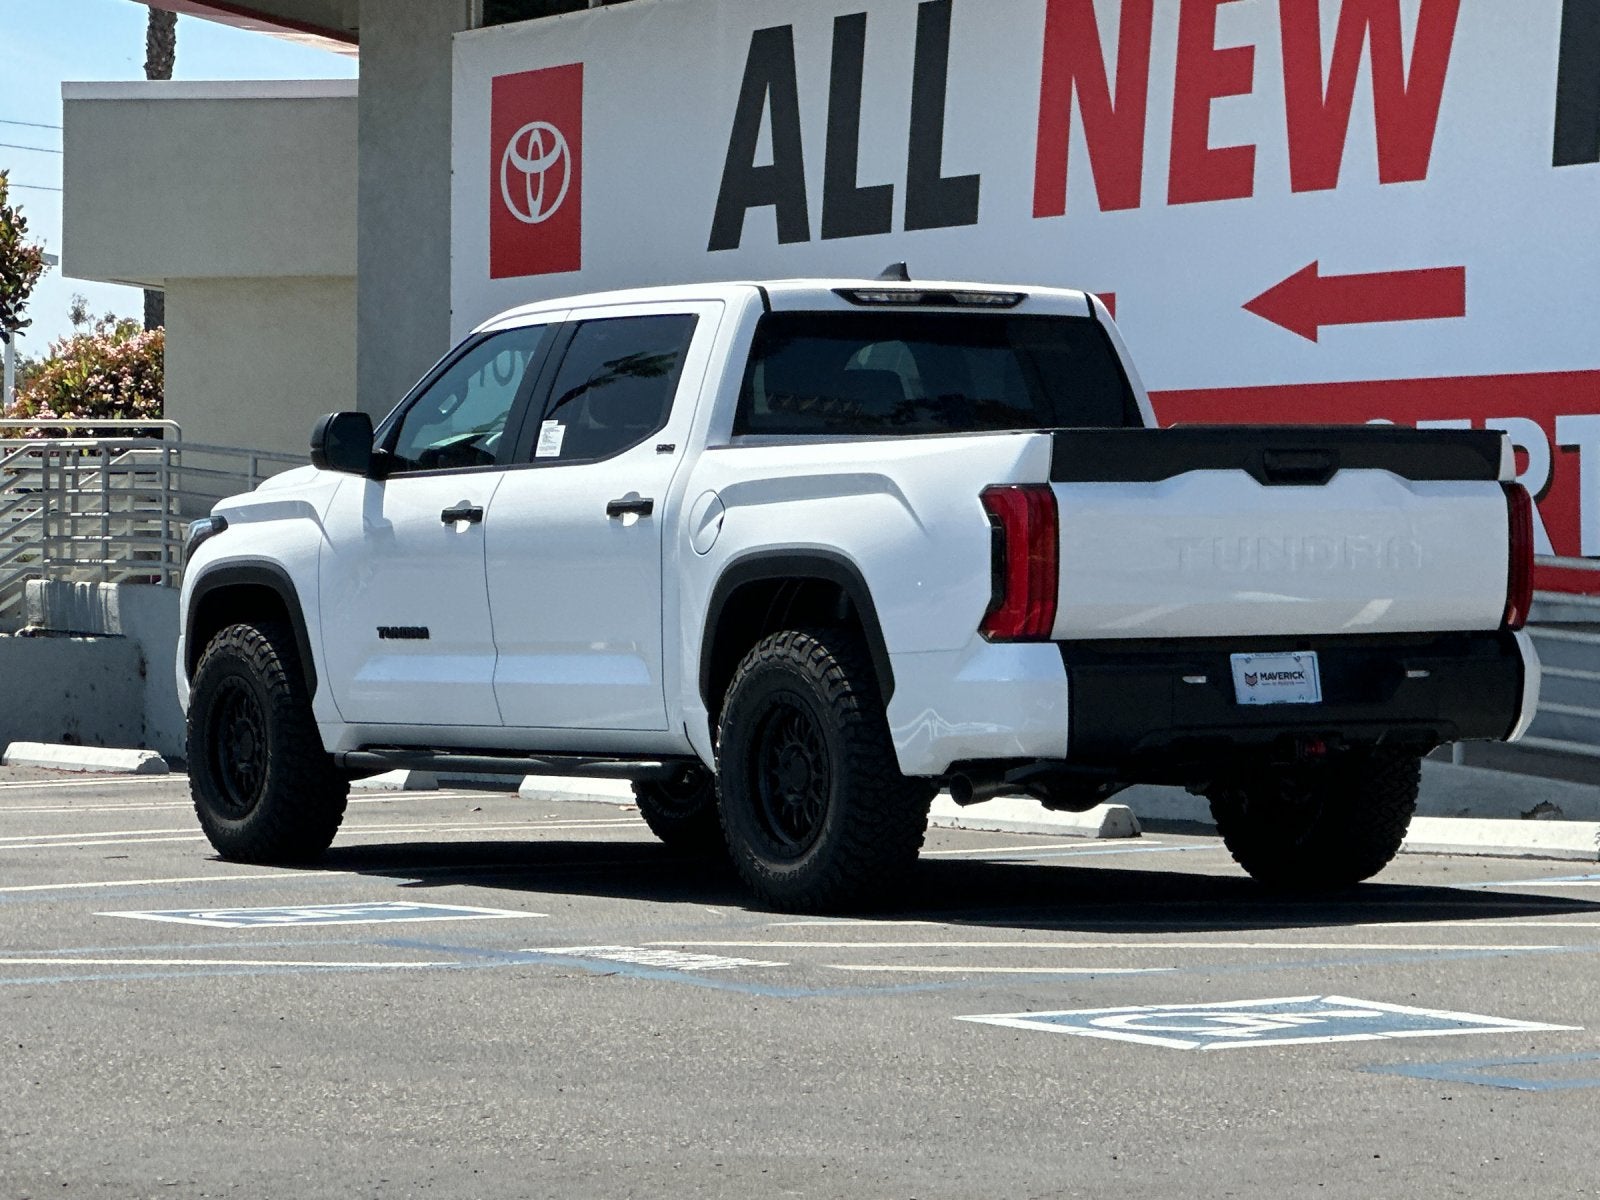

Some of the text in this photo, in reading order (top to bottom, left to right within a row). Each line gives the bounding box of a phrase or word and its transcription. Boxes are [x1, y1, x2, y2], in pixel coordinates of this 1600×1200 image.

[707, 0, 980, 251] ALL
[1033, 0, 1461, 218] NEW
[1164, 535, 1423, 571] TUNDRA
[1259, 671, 1304, 681] MAVERICK
